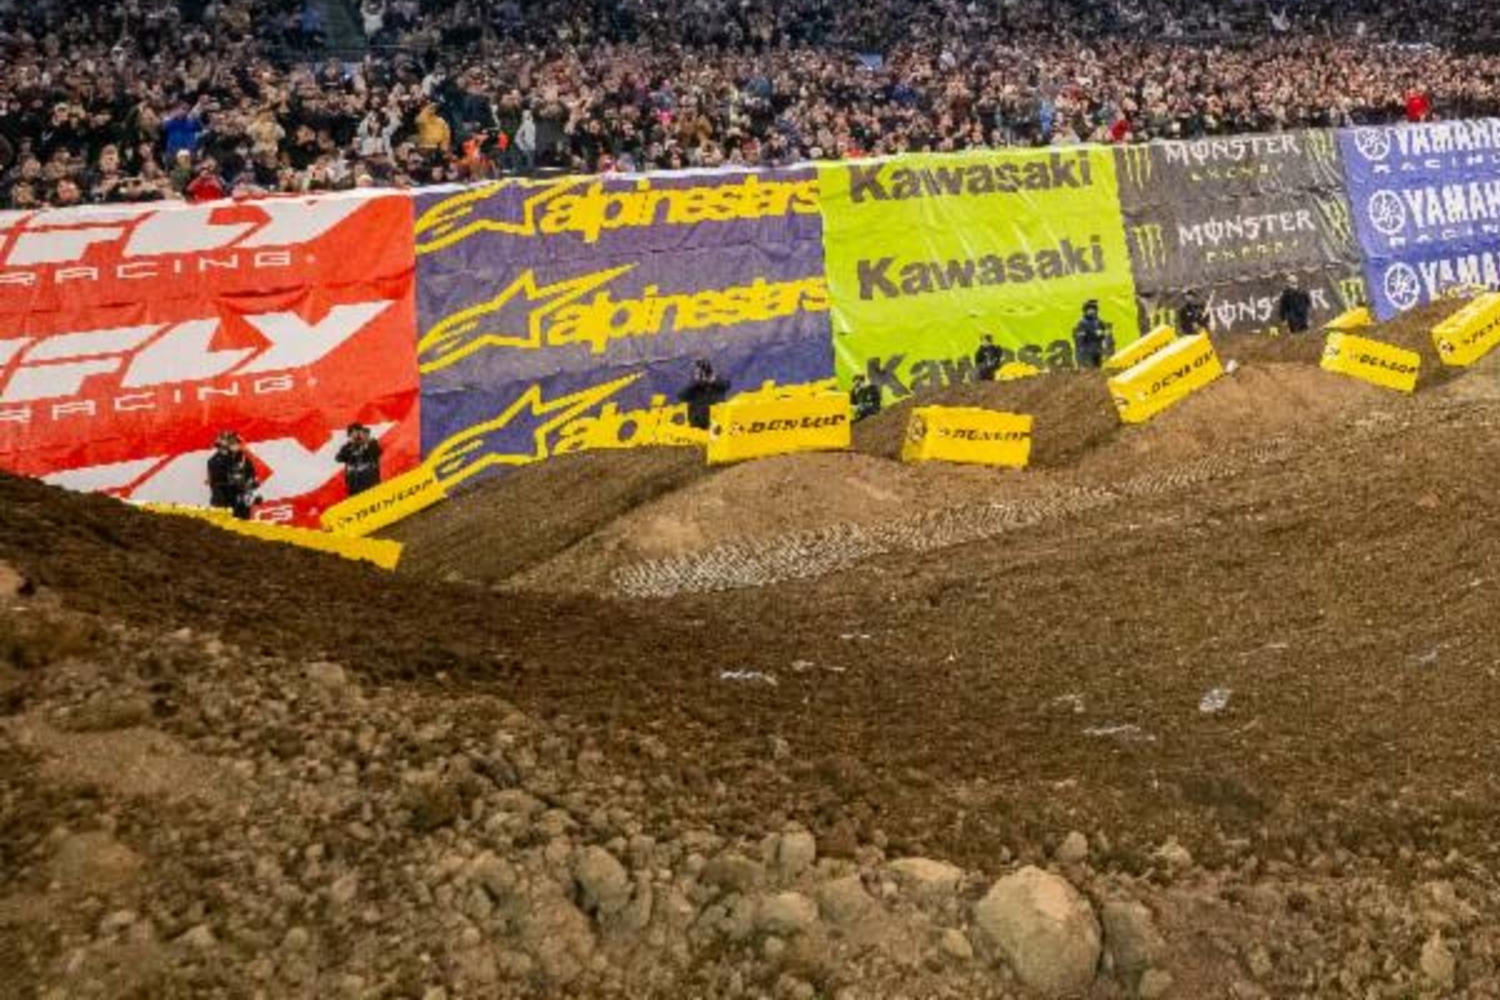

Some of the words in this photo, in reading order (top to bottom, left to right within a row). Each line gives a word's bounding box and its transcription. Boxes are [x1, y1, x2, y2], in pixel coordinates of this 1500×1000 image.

[850, 149, 1094, 203] Kawasaki
[1164, 134, 1302, 167] MONSTER
[539, 174, 820, 245] alpinestars
[1178, 208, 1316, 247] MONSTER
[0, 251, 291, 286] RACING
[857, 234, 1106, 301] Kawasaki
[546, 276, 830, 354] alpinestars
[3, 300, 395, 402] FLY
[0, 375, 294, 424] RACING
